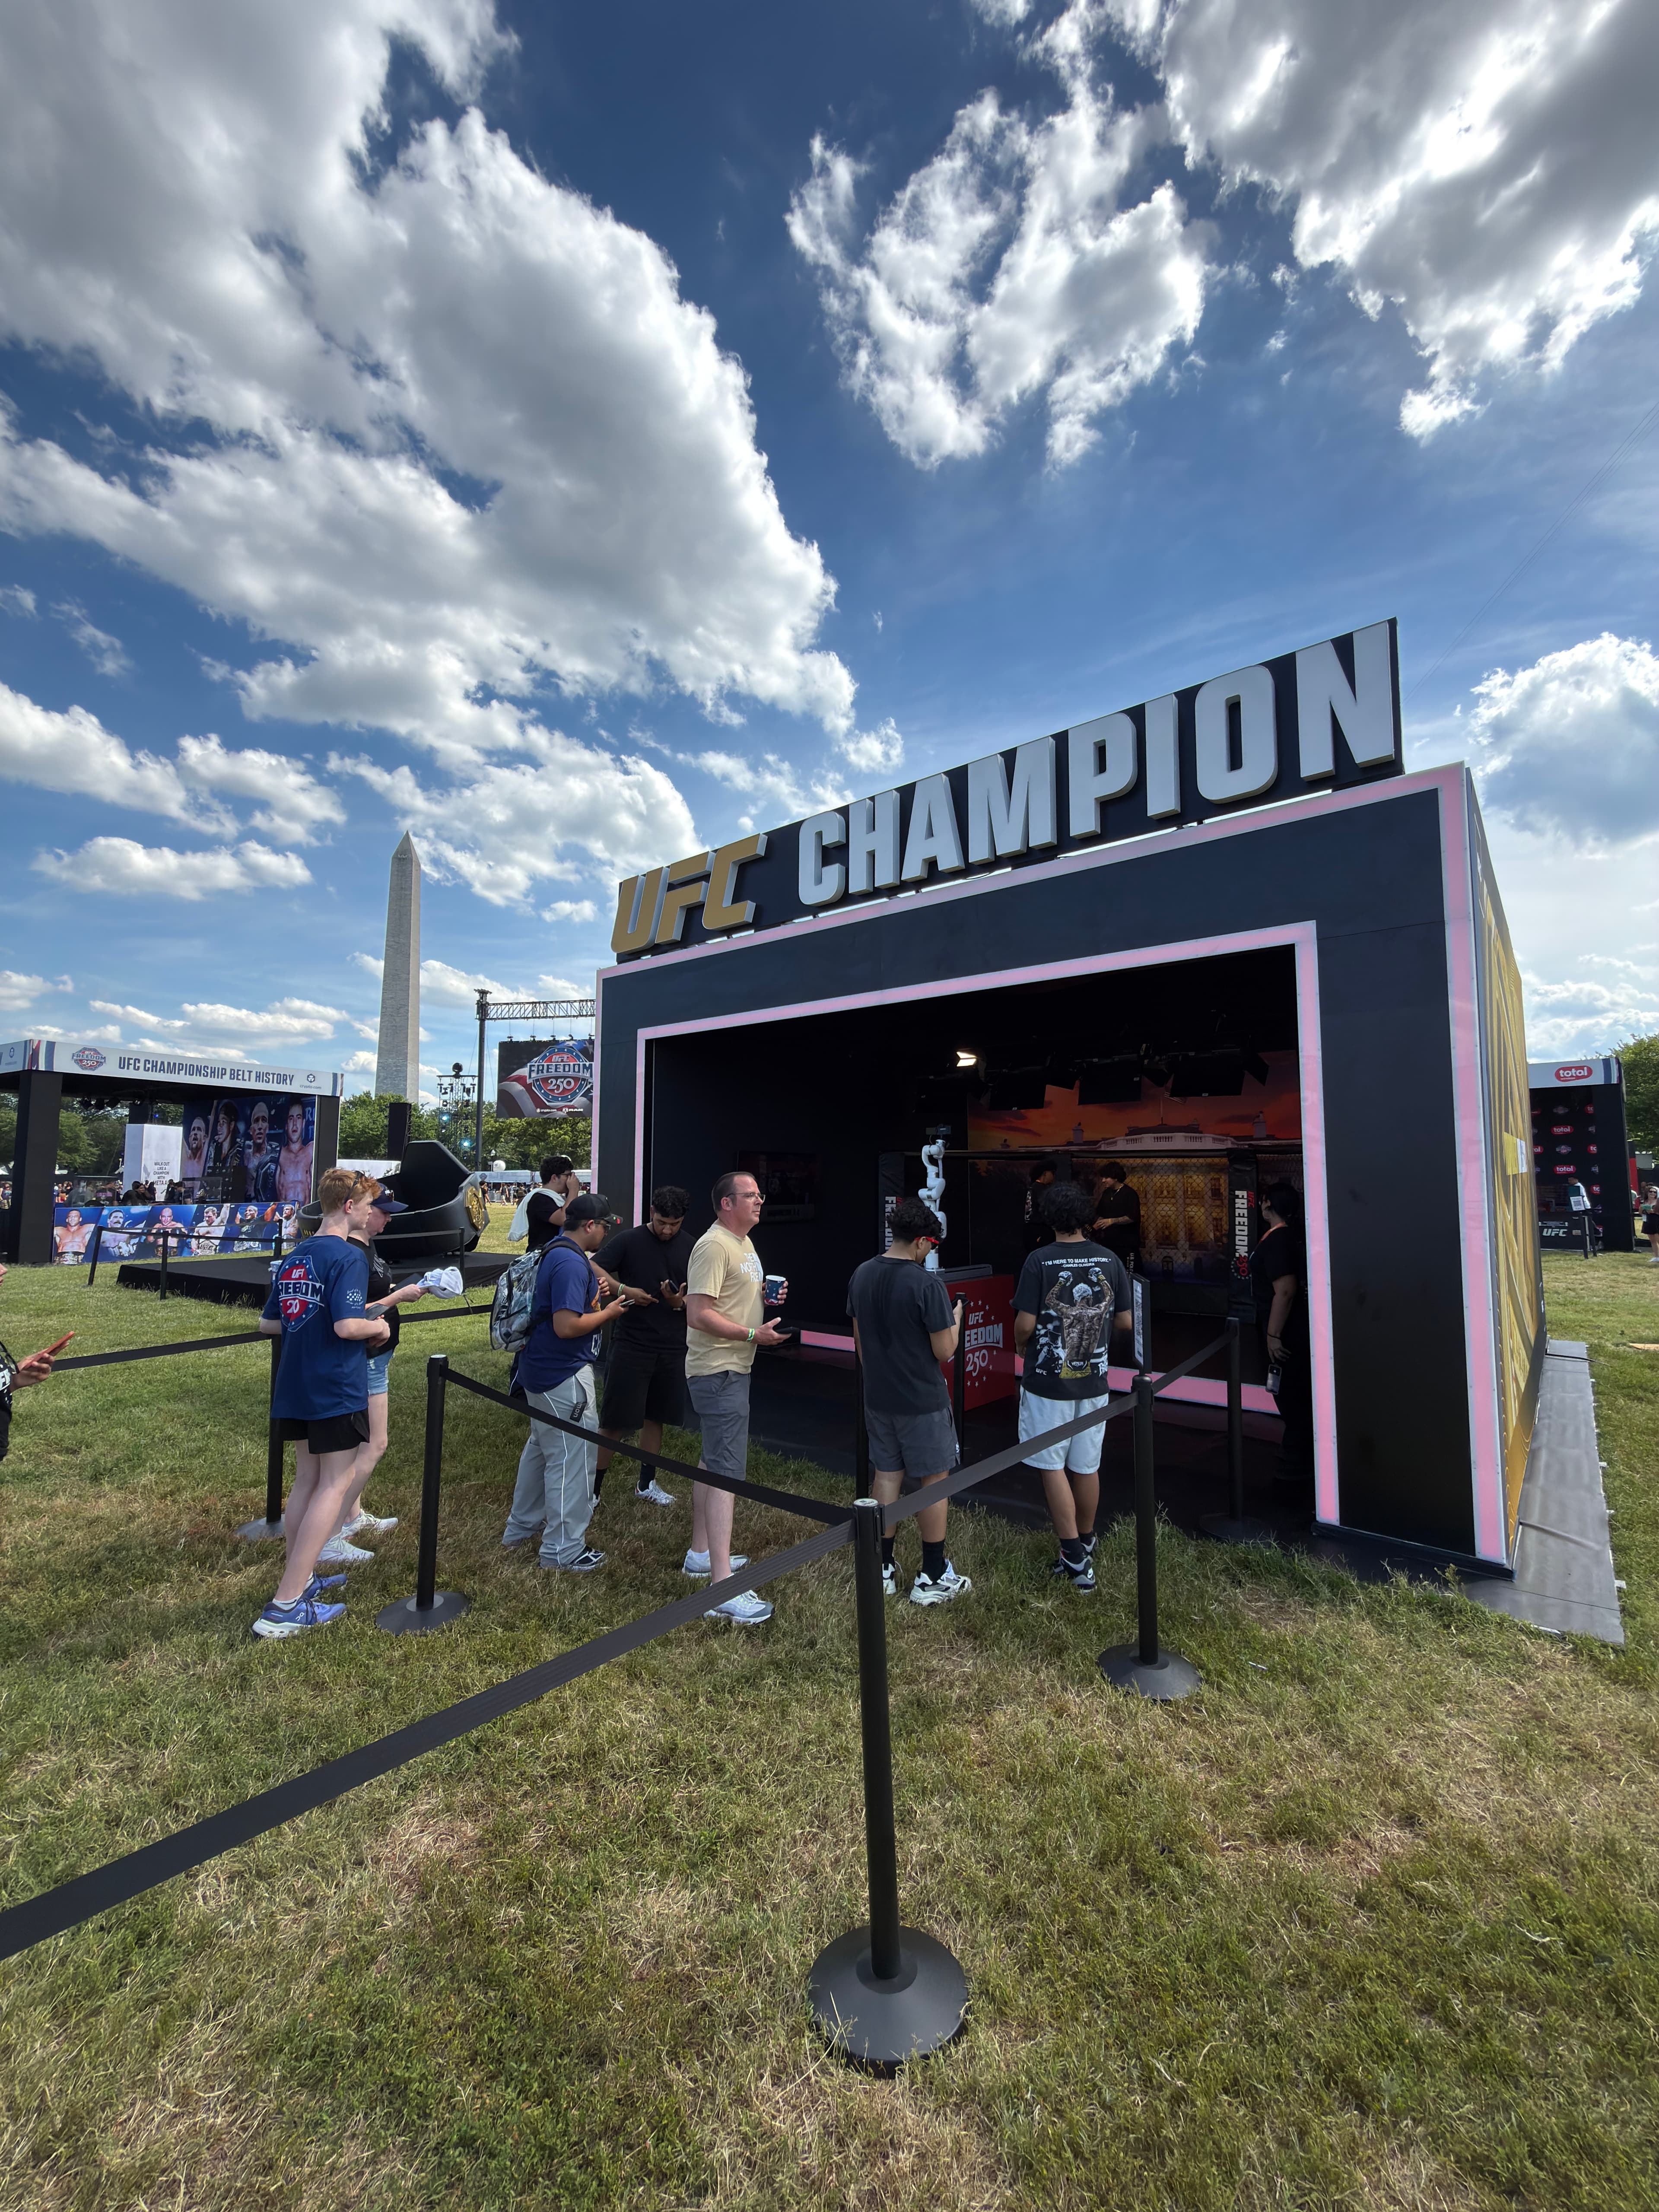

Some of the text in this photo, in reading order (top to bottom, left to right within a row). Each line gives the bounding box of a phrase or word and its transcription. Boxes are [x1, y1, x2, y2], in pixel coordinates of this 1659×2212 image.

[611, 618, 1395, 953] UFC CHAMPION
[72, 1053, 106, 1063] FREEDOM
[118, 1056, 294, 1086] UFC CHAMPIONSHIP BELT HISTORY
[528, 1064, 593, 1079] FREEDOM
[1559, 1067, 1587, 1077] total
[547, 1078, 574, 1093] 250
[1235, 1191, 1248, 1257] FREEDOM
[1542, 1228, 1568, 1236] UFC
[1236, 1254, 1248, 1276] 250
[968, 1311, 984, 1325] UFC
[965, 1322, 1003, 1348] EEDOM
[966, 1349, 988, 1377] 250
